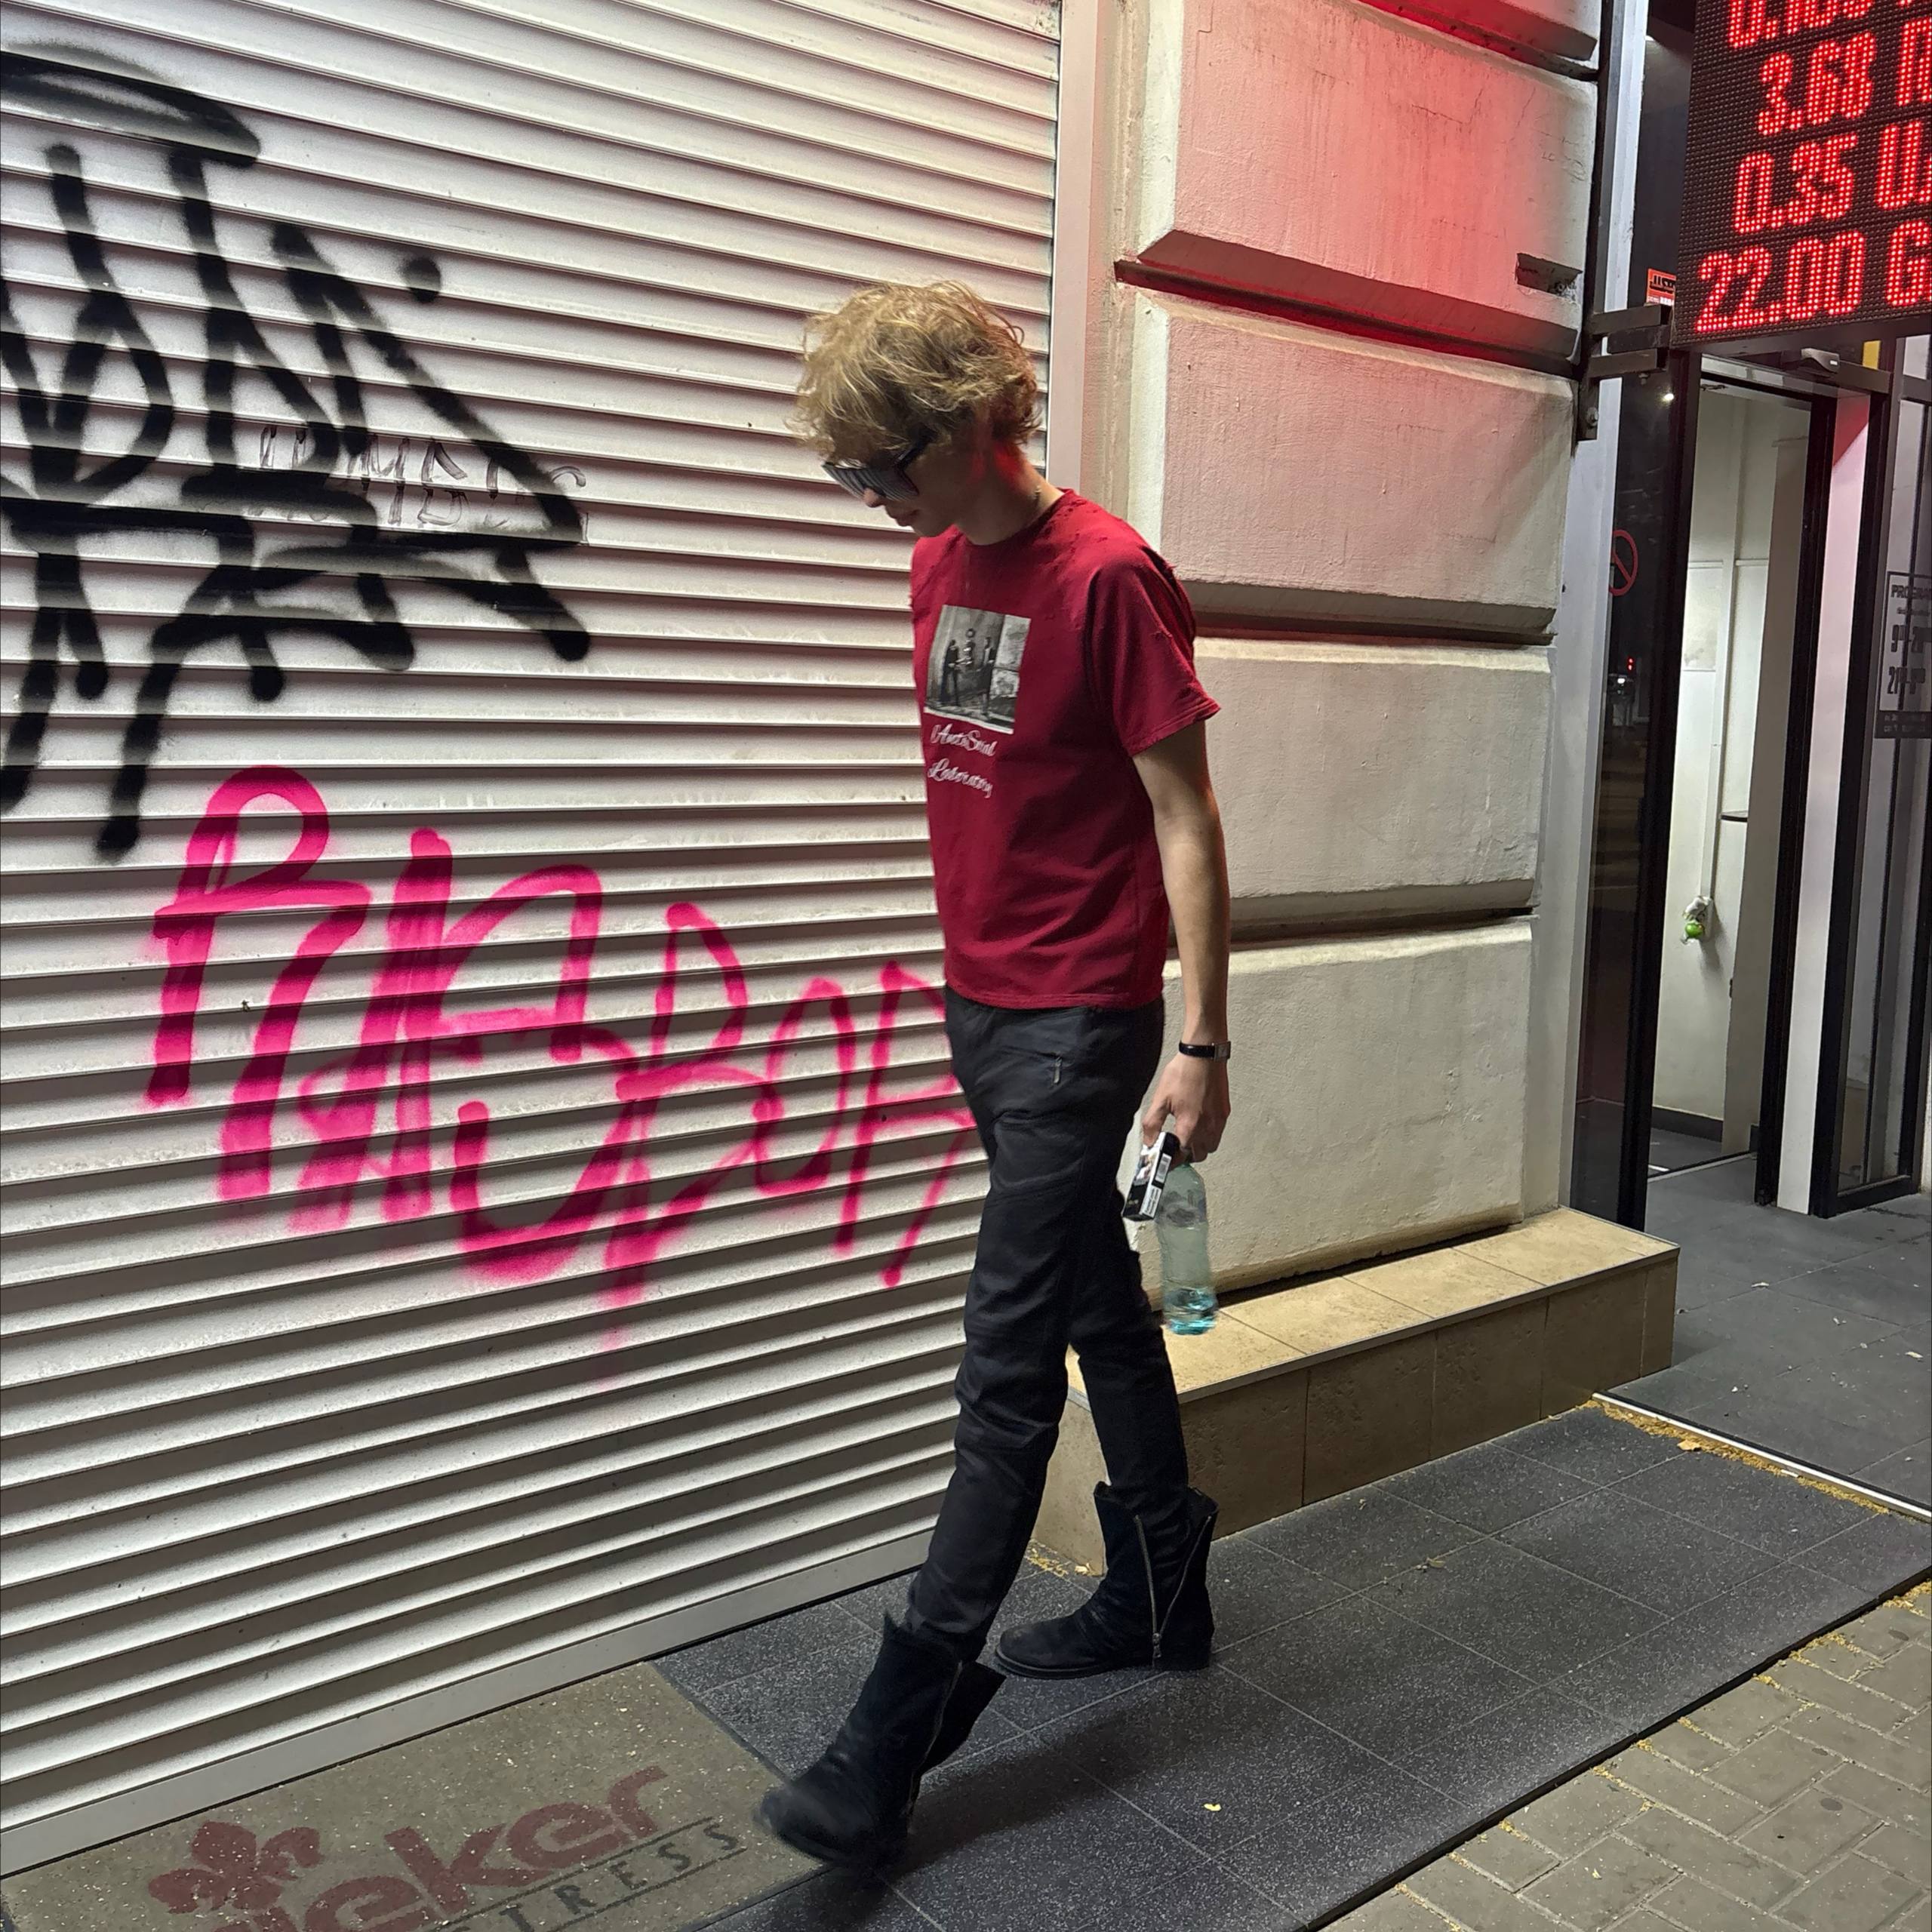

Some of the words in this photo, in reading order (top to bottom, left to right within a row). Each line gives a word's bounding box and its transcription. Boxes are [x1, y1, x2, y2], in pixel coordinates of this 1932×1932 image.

[1757, 30, 1876, 136] 3.68
[1734, 132, 1858, 235] 0.35
[1695, 230, 1866, 333] 22.00
